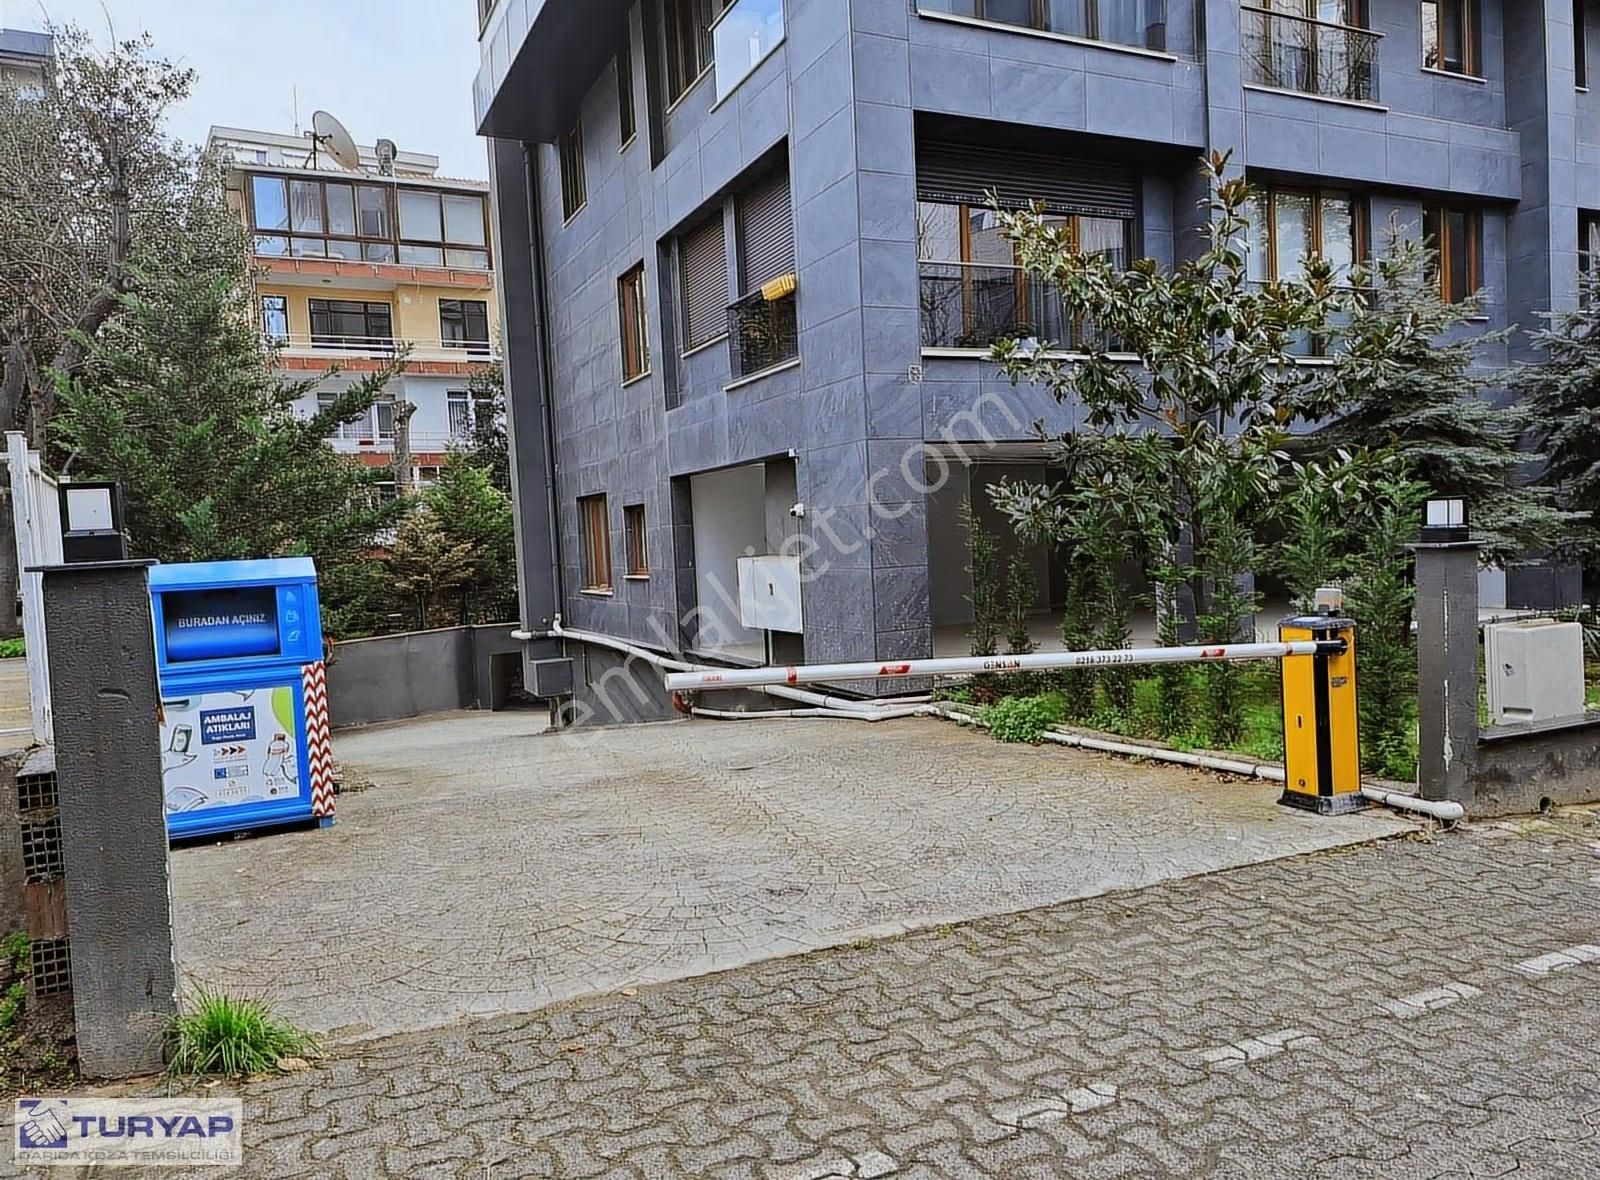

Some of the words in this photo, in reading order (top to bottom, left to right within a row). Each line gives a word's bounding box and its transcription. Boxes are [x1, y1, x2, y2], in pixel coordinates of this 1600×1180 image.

[178, 615, 229, 628] BURADAN
[204, 712, 251, 724] AMBALAJ
[206, 722, 250, 733] ATIKLARI
